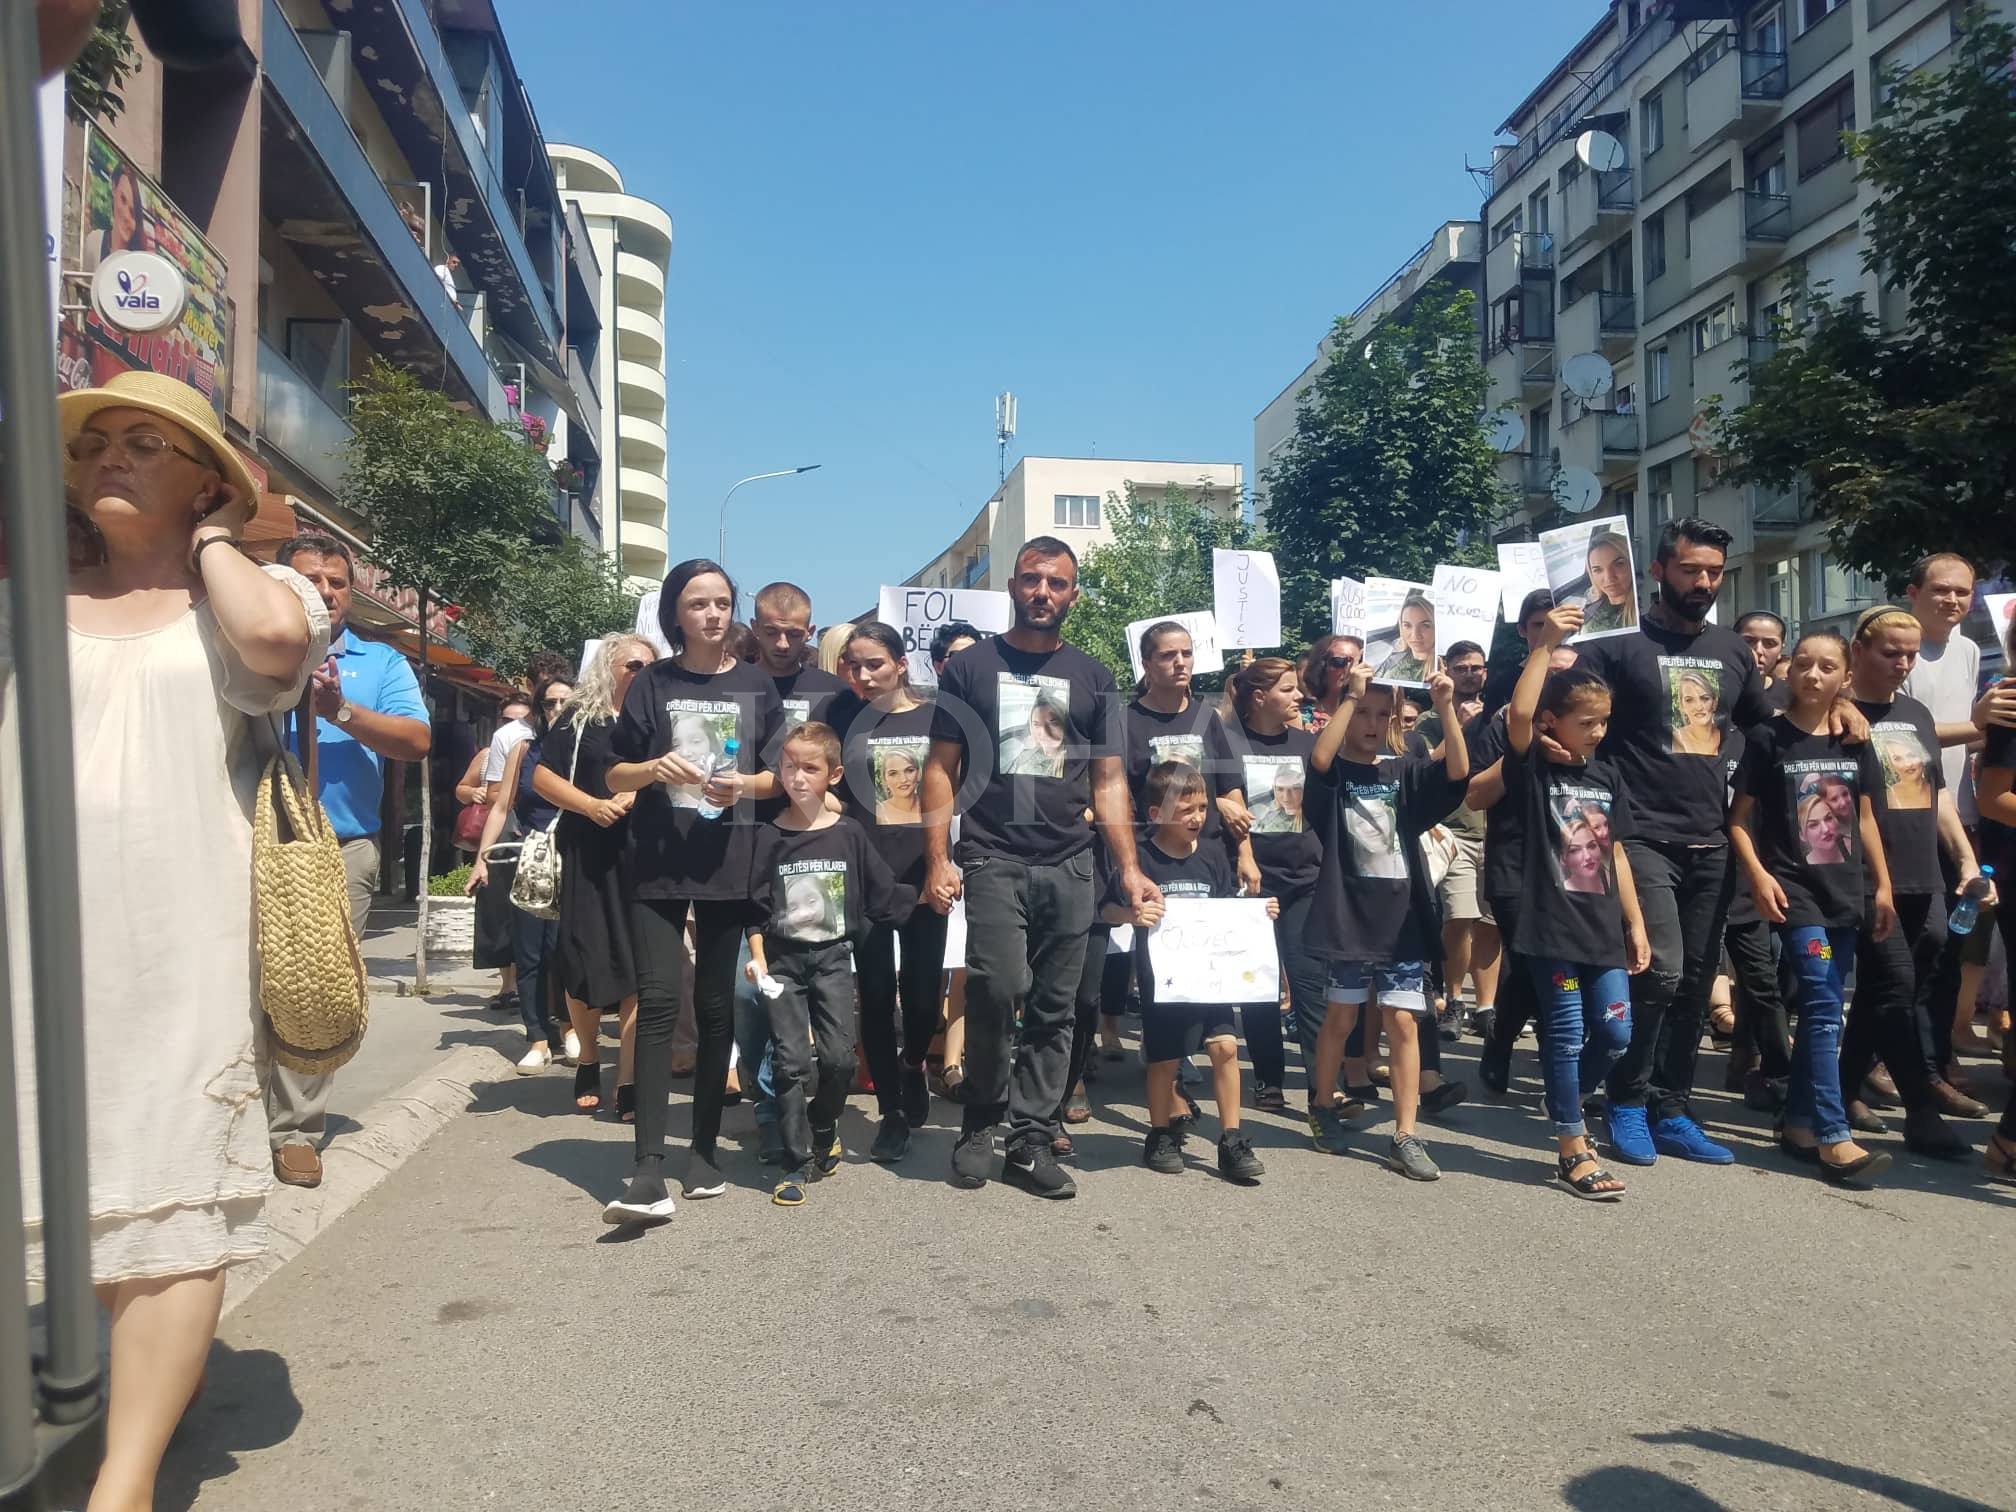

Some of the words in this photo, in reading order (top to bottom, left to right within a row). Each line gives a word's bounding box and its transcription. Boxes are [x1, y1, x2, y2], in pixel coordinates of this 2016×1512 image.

[115, 291, 160, 308] vala
[1443, 575, 1478, 594] NO
[905, 591, 968, 622] FOL
[810, 860, 823, 872] PËR
[823, 861, 847, 872] KLAREN
